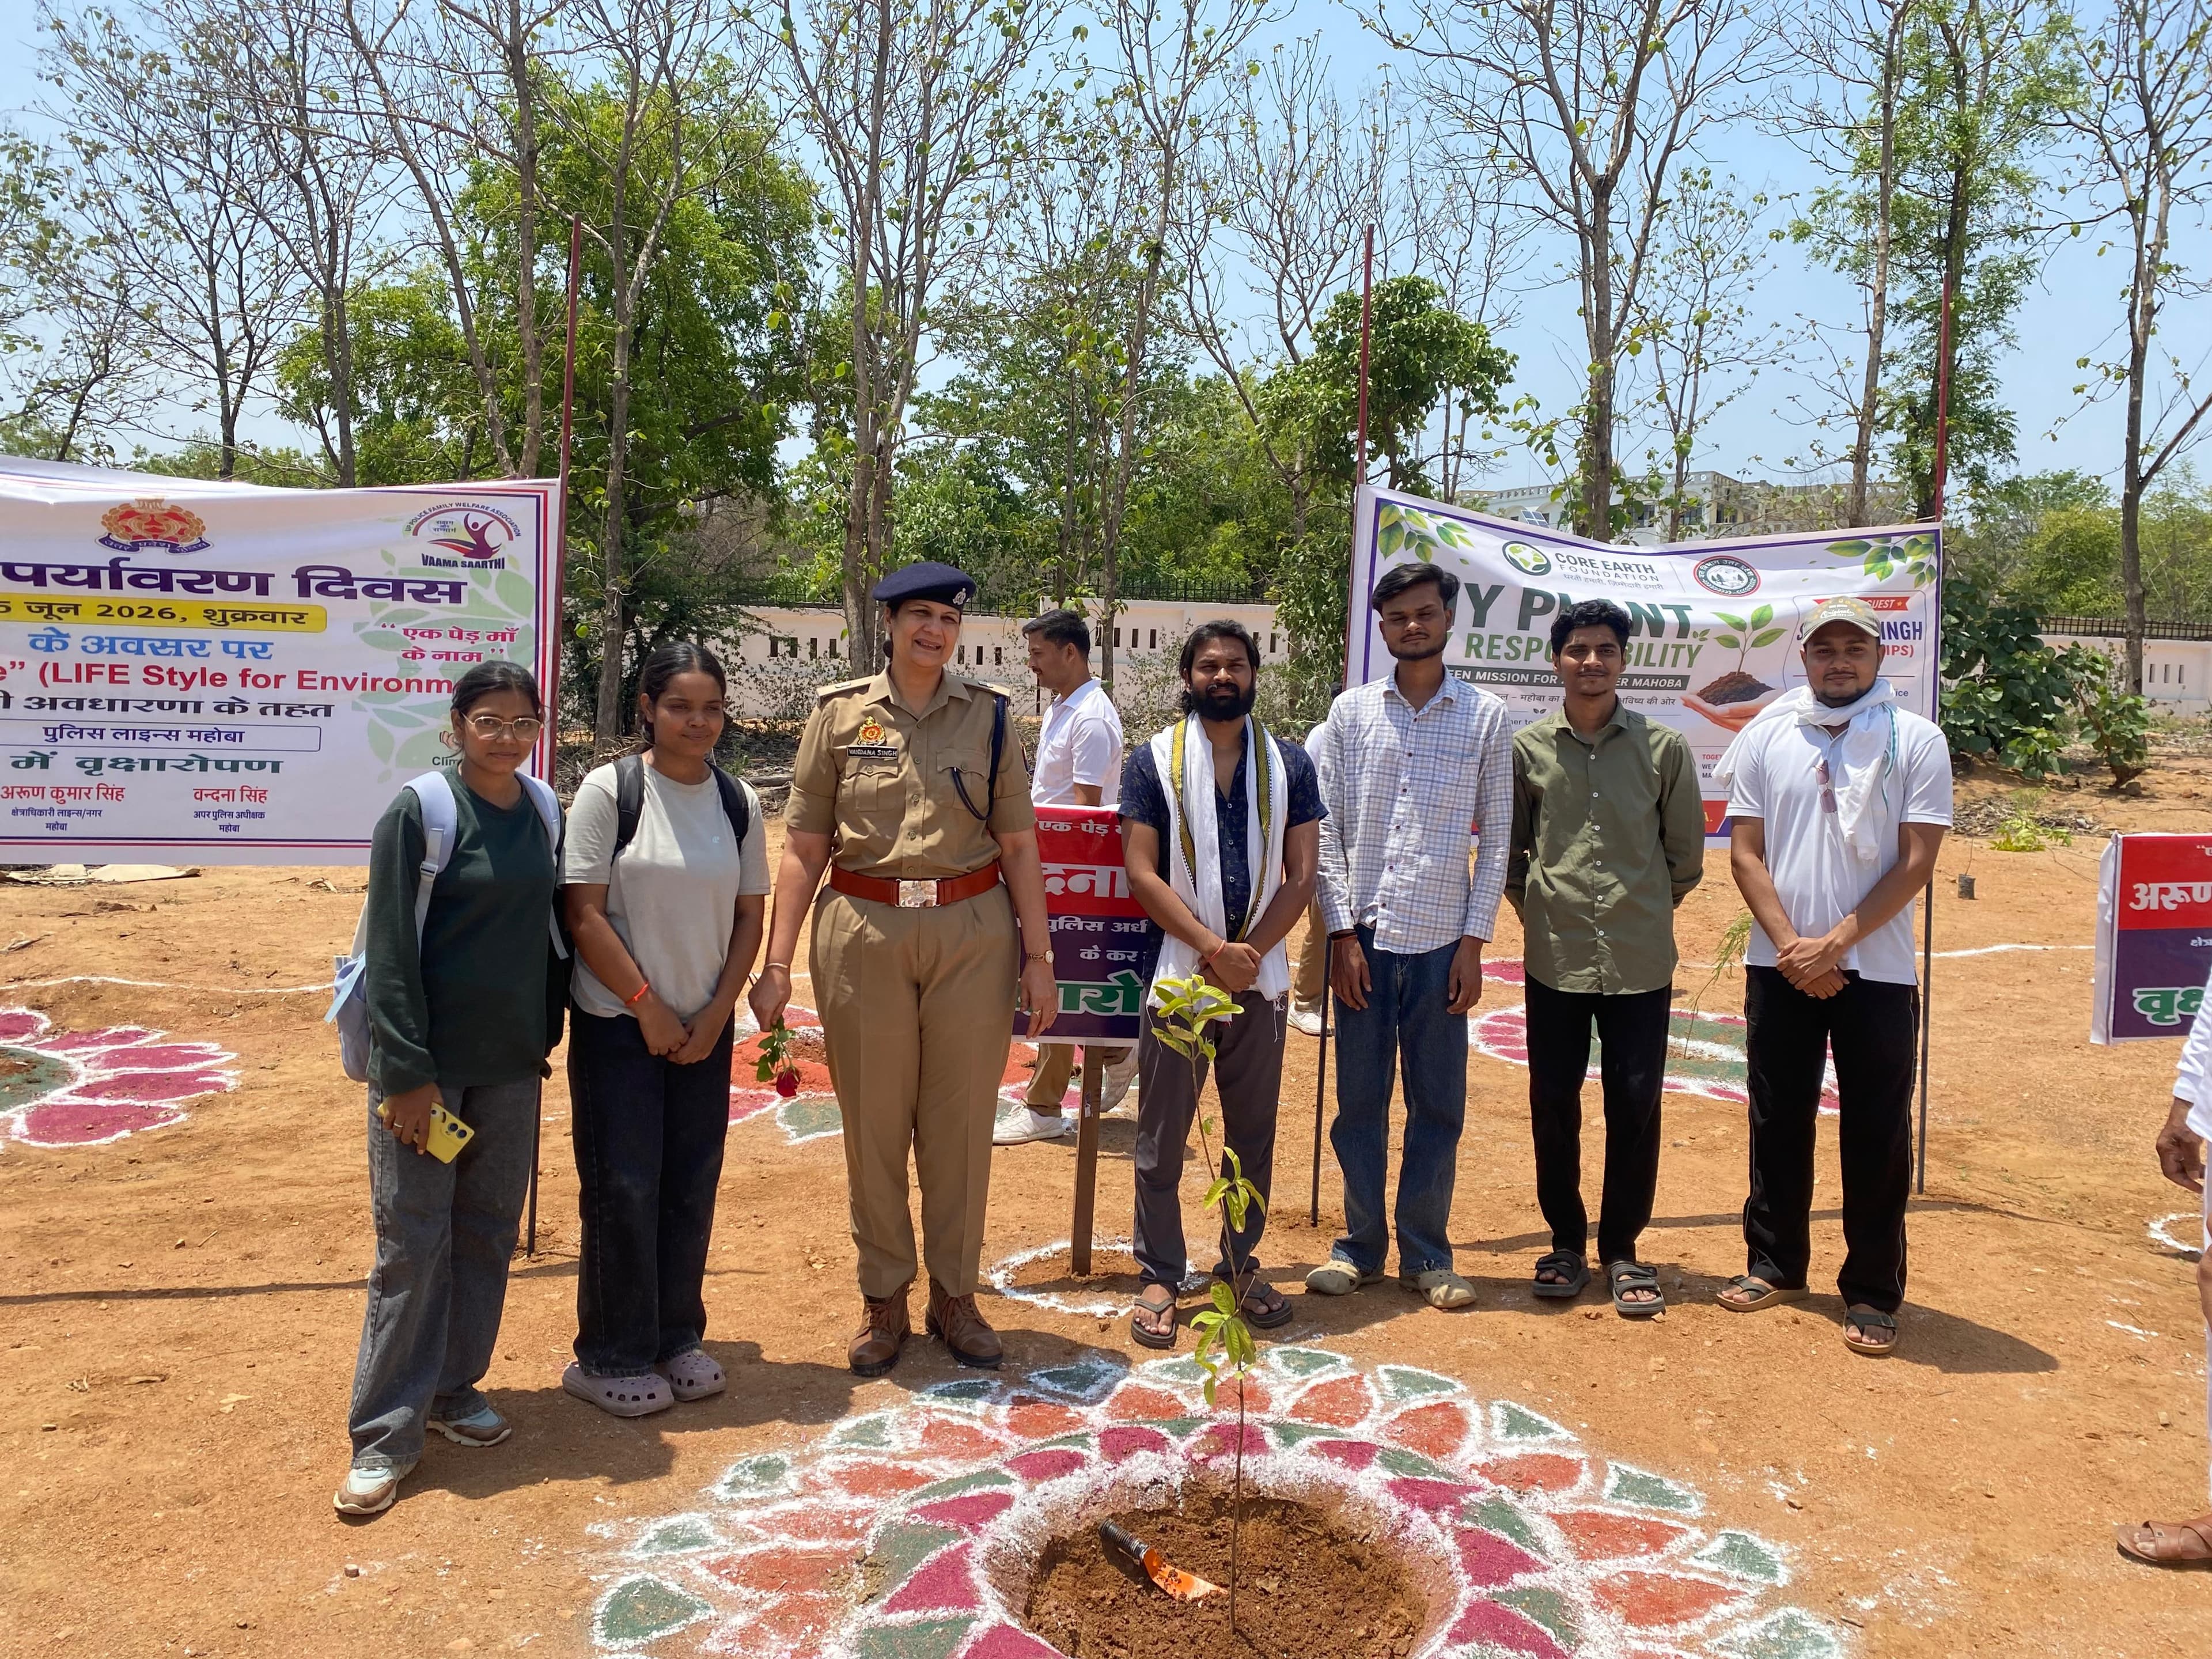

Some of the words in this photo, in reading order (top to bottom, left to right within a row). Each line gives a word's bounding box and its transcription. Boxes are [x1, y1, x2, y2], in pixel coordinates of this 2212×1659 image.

[410, 510, 429, 525] POLICE
[429, 503, 453, 513] FAMILY
[455, 502, 490, 511] WELFARE
[490, 508, 521, 537] ASSOCIATION
[421, 553, 458, 567] VAAMA
[461, 557, 505, 569] SAARTHI
[1555, 553, 1599, 569] CORE
[1601, 560, 1656, 574] EARTH
[0, 557, 275, 596] पर्यावरण
[291, 565, 467, 604] दिवस
[1559, 564, 1660, 581] FOUNDATION
[24, 601, 82, 620] जून
[96, 604, 187, 623] 2026,
[202, 608, 308, 626] शुक्रवार
[447, 626, 480, 645] पेड़
[486, 627, 520, 642] माँ
[1881, 621, 1922, 640] INGH
[27, 626, 71, 653] के
[81, 635, 211, 658] अवसर
[221, 640, 274, 660] पर
[1887, 645, 1914, 657] IPS)
[401, 646, 426, 661] के
[39, 661, 130, 688] (LIFE
[142, 665, 228, 692] Style
[239, 668, 286, 689] for
[297, 670, 453, 694] Environm
[1475, 671, 1529, 683] MISSION
[1533, 674, 1558, 684] FOR
[1632, 678, 1681, 687] MAHOBA
[23, 696, 204, 714] अवधारणा
[213, 696, 250, 715] के
[258, 702, 335, 718] तहत
[1521, 693, 1546, 702] महोबा
[1646, 696, 1658, 705] की
[1661, 696, 1676, 705] ओर
[43, 724, 106, 743] पुलिस
[111, 728, 181, 743] लाइन्स
[187, 727, 245, 743] महोबा
[10, 751, 58, 770] में
[75, 753, 283, 776] वृक्षारोपण
[1, 786, 46, 800] अरूण
[50, 786, 93, 804] कुमार
[96, 783, 126, 801] सिंह
[193, 789, 236, 802] वन्दना
[240, 785, 268, 804] सिंह
[194, 810, 211, 819] अपर
[212, 809, 234, 821] पुलिस
[235, 809, 265, 819] अधीक्षक
[46, 821, 67, 831] महोबा
[219, 823, 240, 832] महोबा
[1080, 944, 1101, 960] के
[1106, 950, 1138, 962] कर
